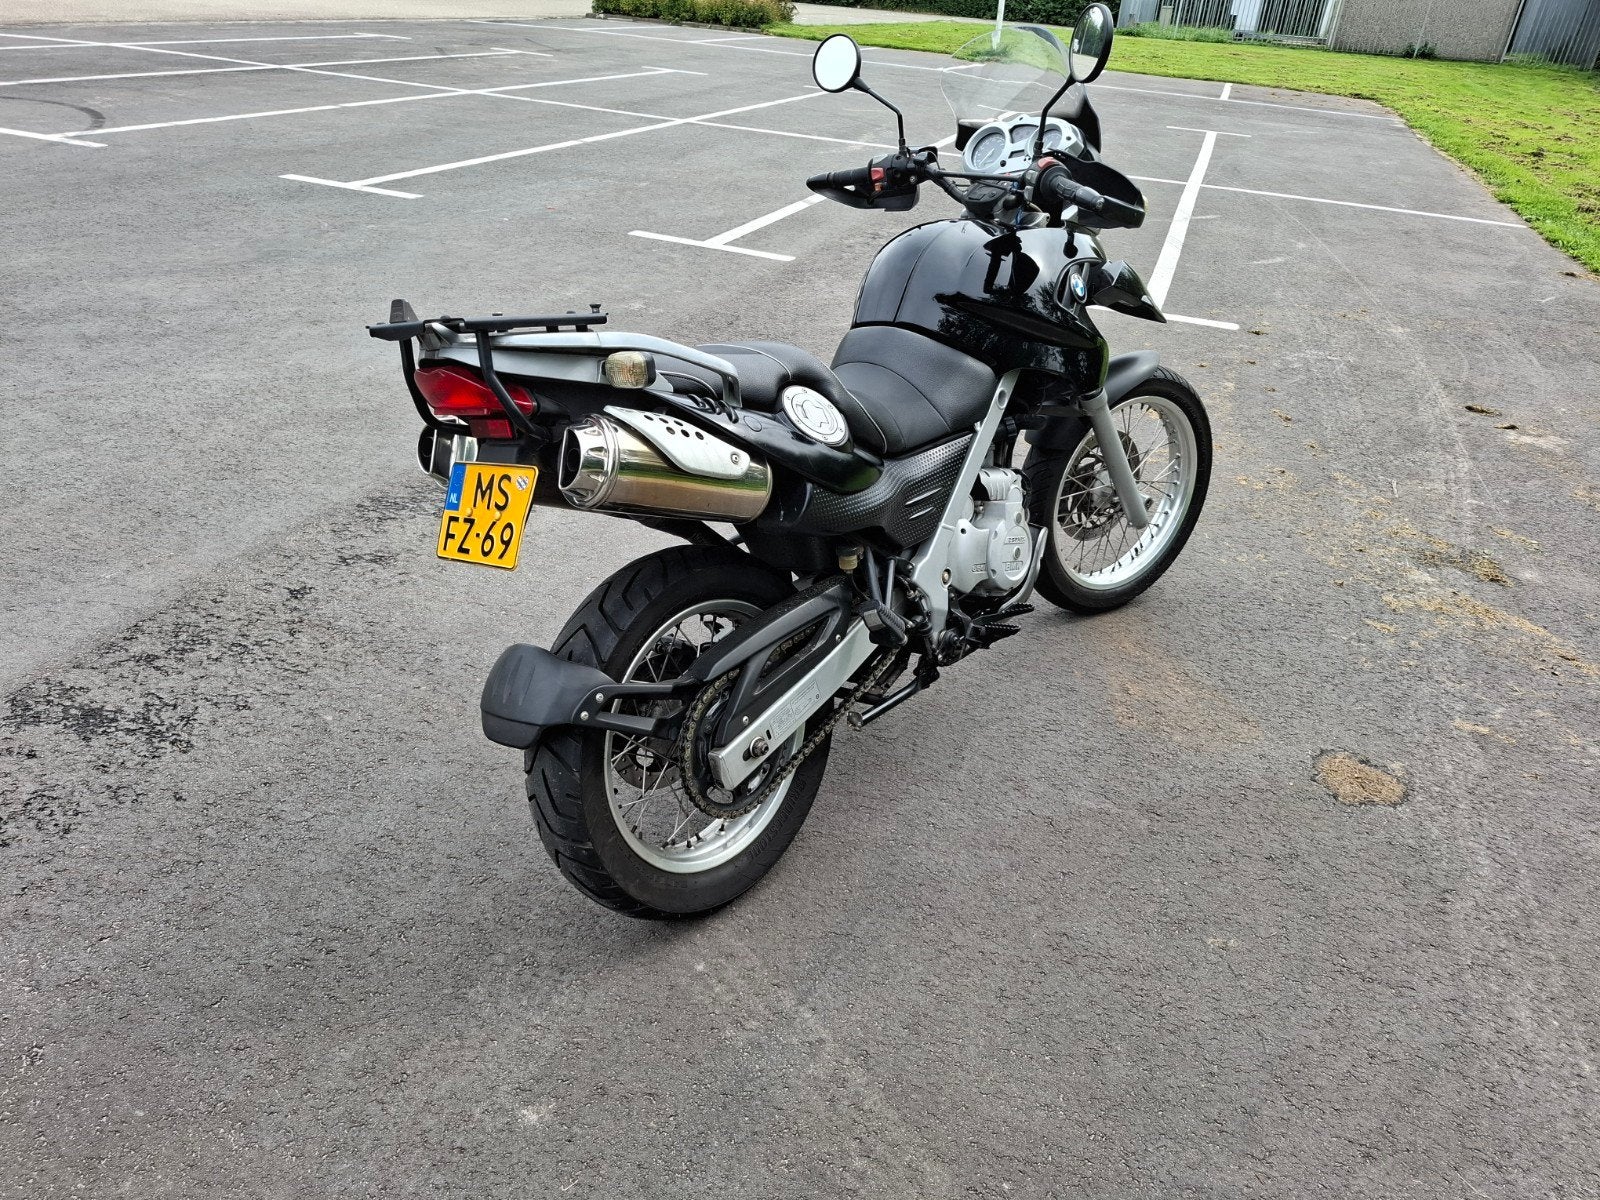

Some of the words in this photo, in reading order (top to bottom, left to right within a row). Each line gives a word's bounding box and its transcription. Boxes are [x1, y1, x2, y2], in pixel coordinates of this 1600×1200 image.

[449, 492, 459, 504] NL
[473, 472, 512, 511] MS
[443, 516, 514, 559] FZ-69
